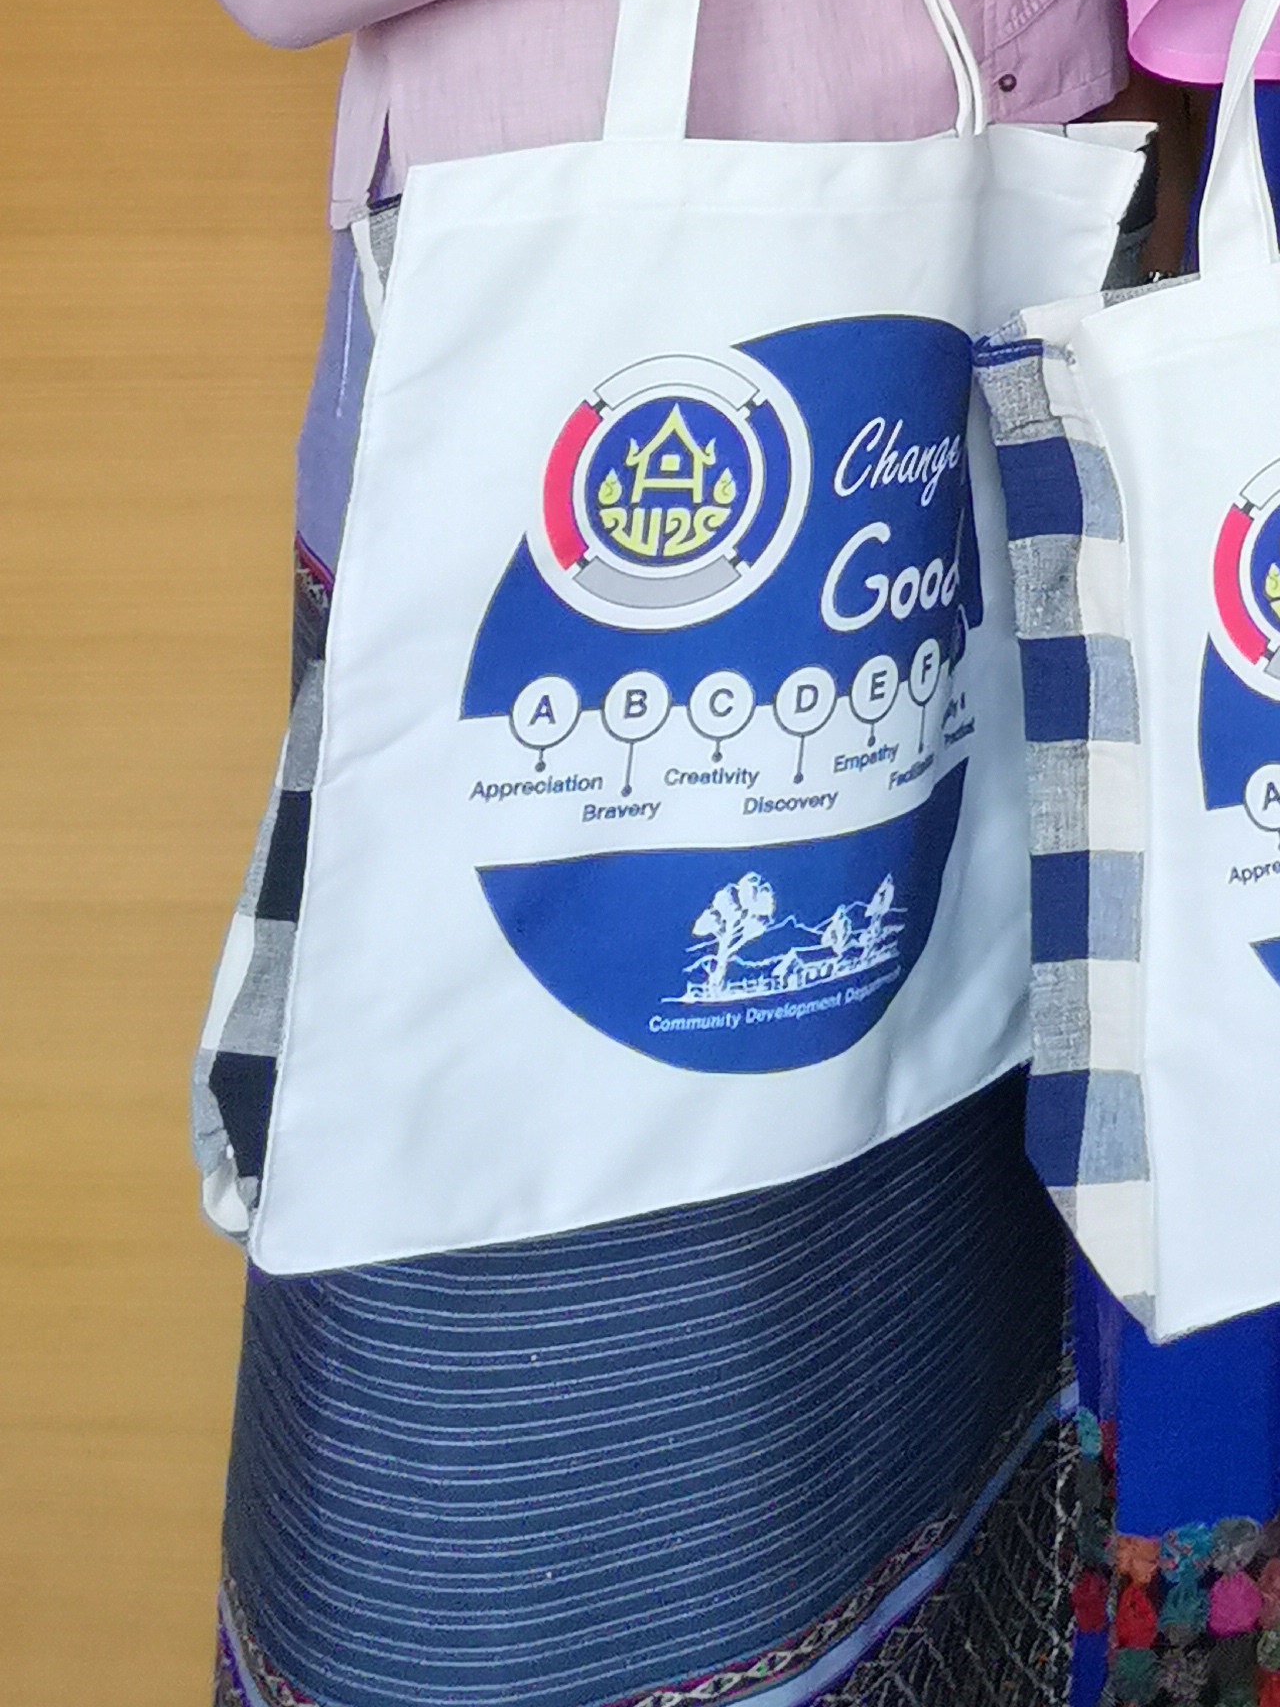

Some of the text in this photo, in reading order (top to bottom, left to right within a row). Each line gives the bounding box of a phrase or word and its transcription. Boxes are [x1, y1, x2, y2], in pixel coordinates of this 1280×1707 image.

[834, 416, 961, 507] Change
[820, 507, 964, 632] Good
[528, 653, 933, 726] A B C D E F
[834, 744, 899, 773] Empathy
[469, 774, 603, 801] Appreciation
[664, 768, 760, 788] Creativity
[582, 801, 661, 822] Bravery
[743, 792, 838, 815] Discovery
[649, 994, 841, 1033] Community Development
